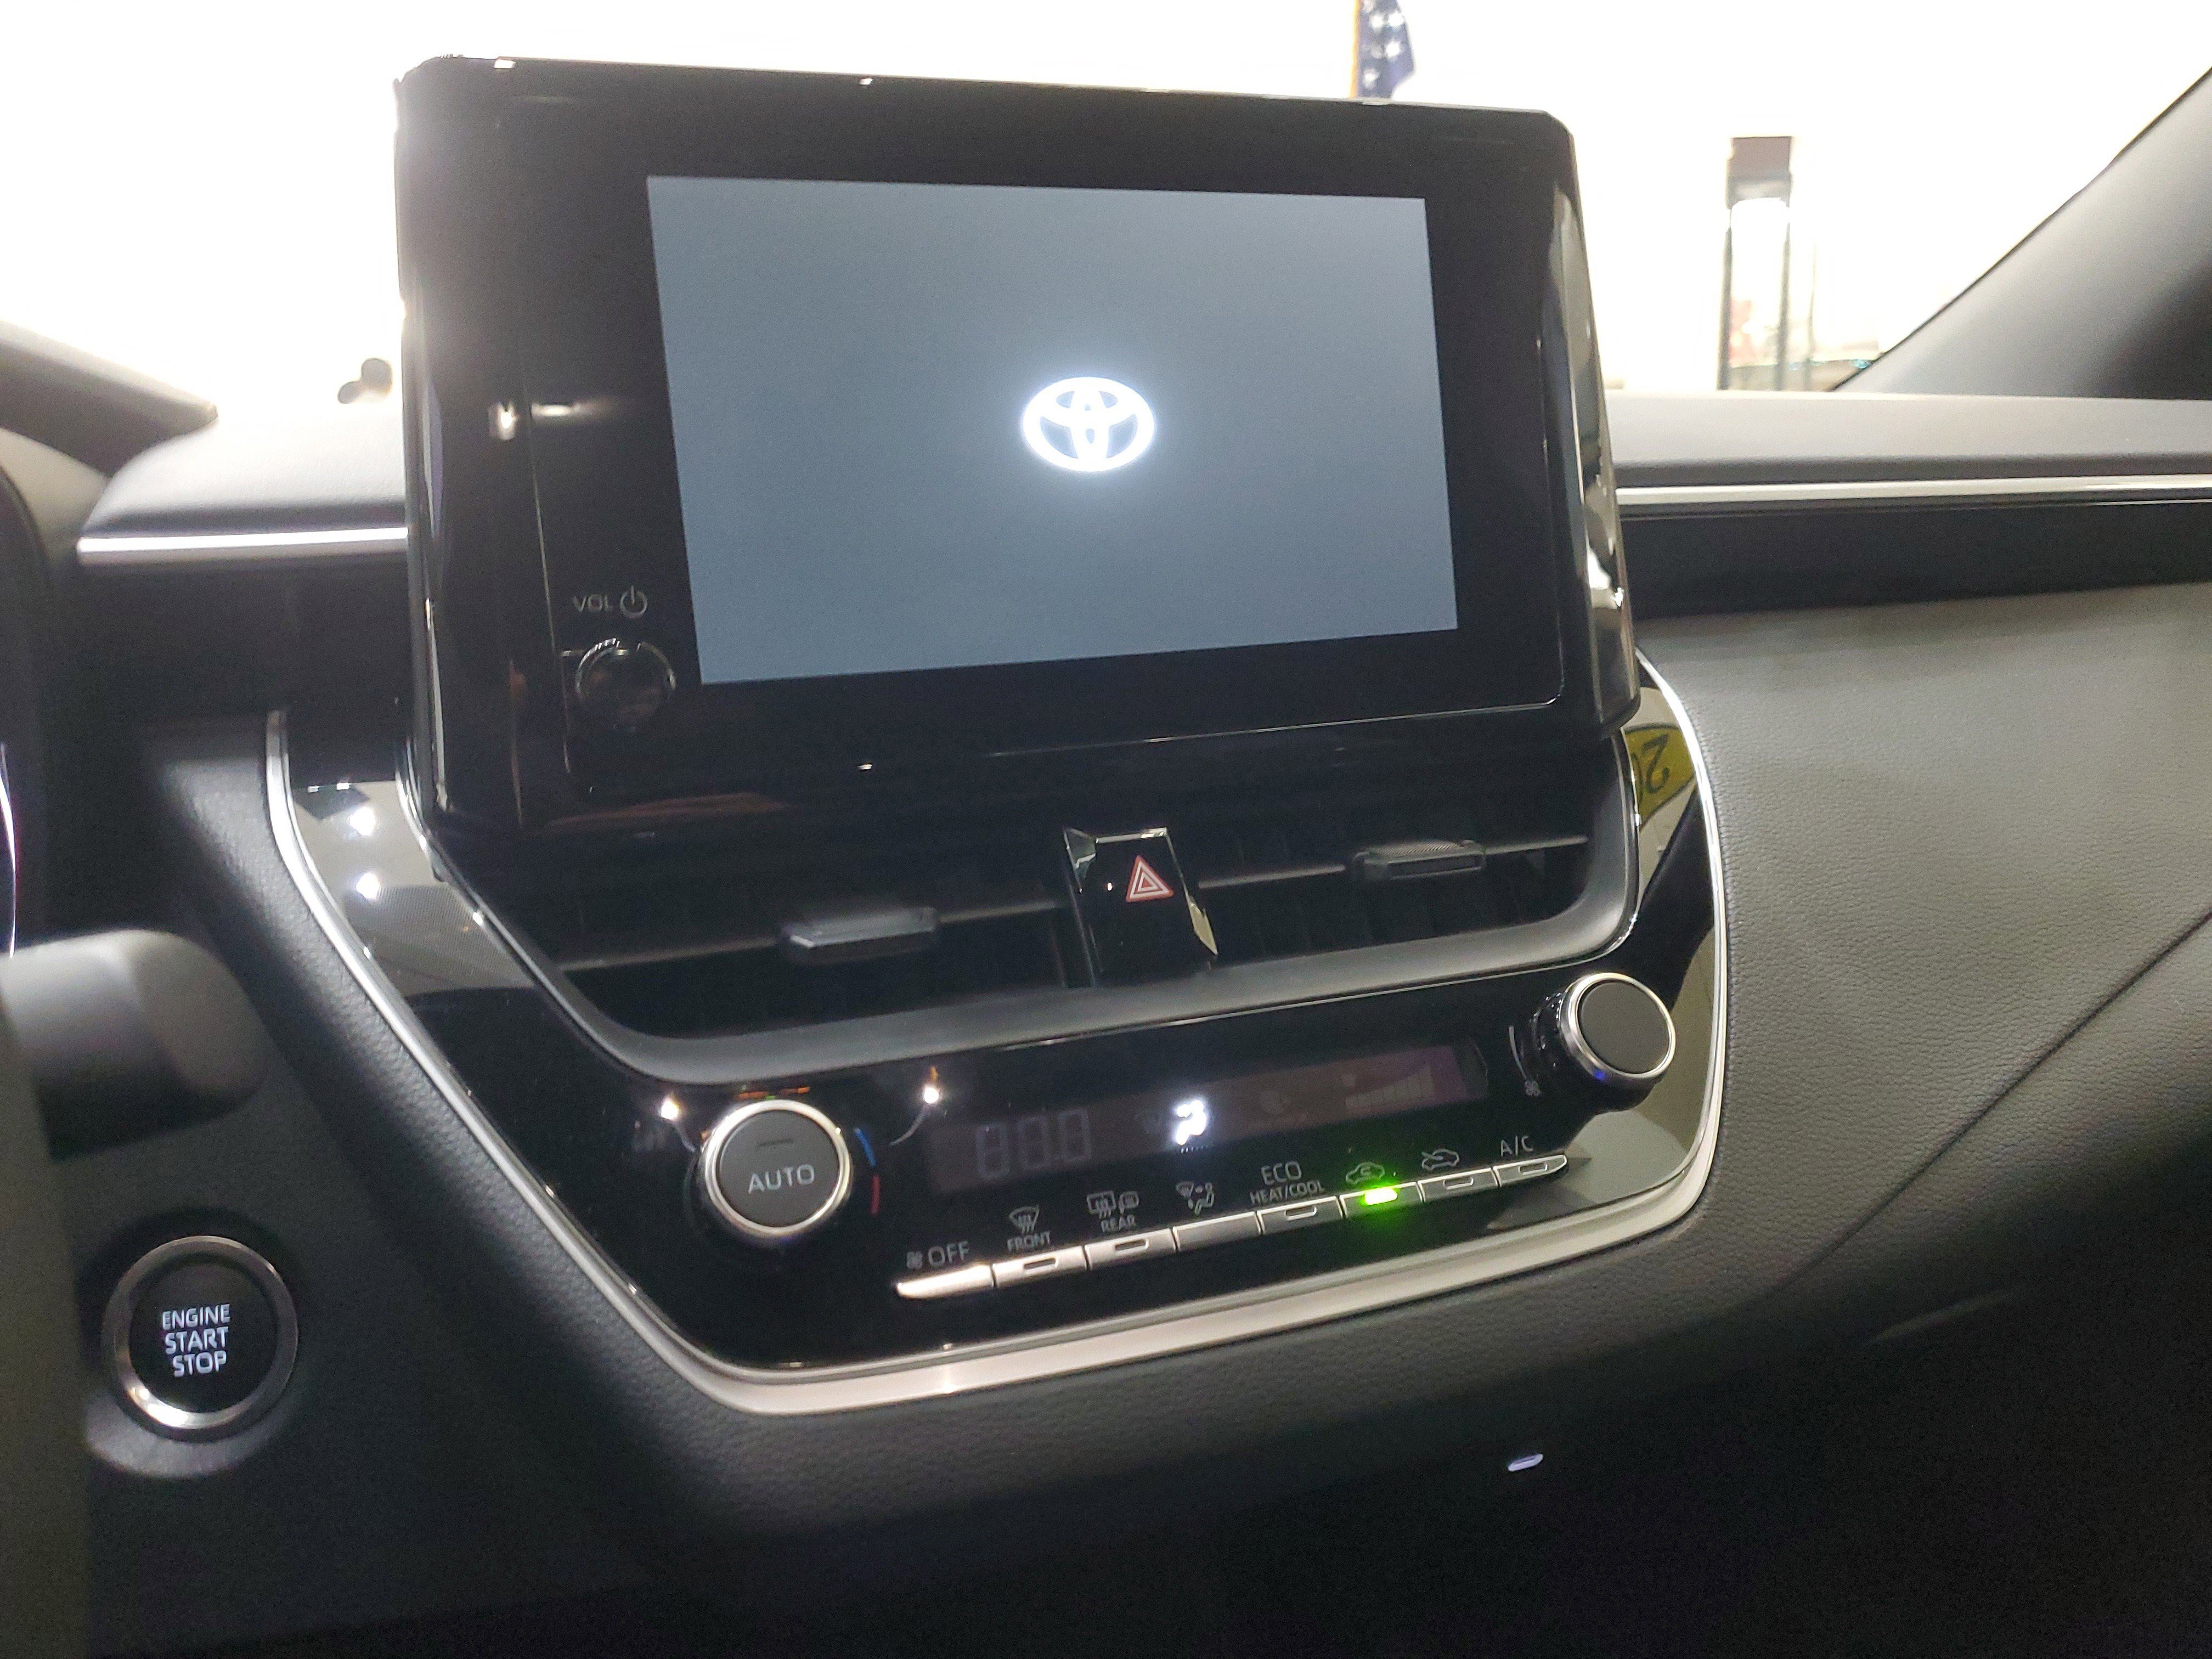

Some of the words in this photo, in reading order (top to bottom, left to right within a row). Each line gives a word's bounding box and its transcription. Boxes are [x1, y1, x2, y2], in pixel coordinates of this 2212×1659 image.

[573, 594, 613, 613] VOL
[1500, 1135, 1534, 1157] A/C
[748, 1164, 815, 1194] AUTO
[1261, 1160, 1302, 1186] ECO
[1250, 1178, 1324, 1205] HEAT/COOL
[1100, 1214, 1137, 1234] REAR
[928, 1240, 970, 1268] OFF
[1007, 1231, 1052, 1253] FRONT
[161, 1304, 231, 1330] ENGINE
[164, 1327, 229, 1355] START
[172, 1350, 227, 1378] STOP
